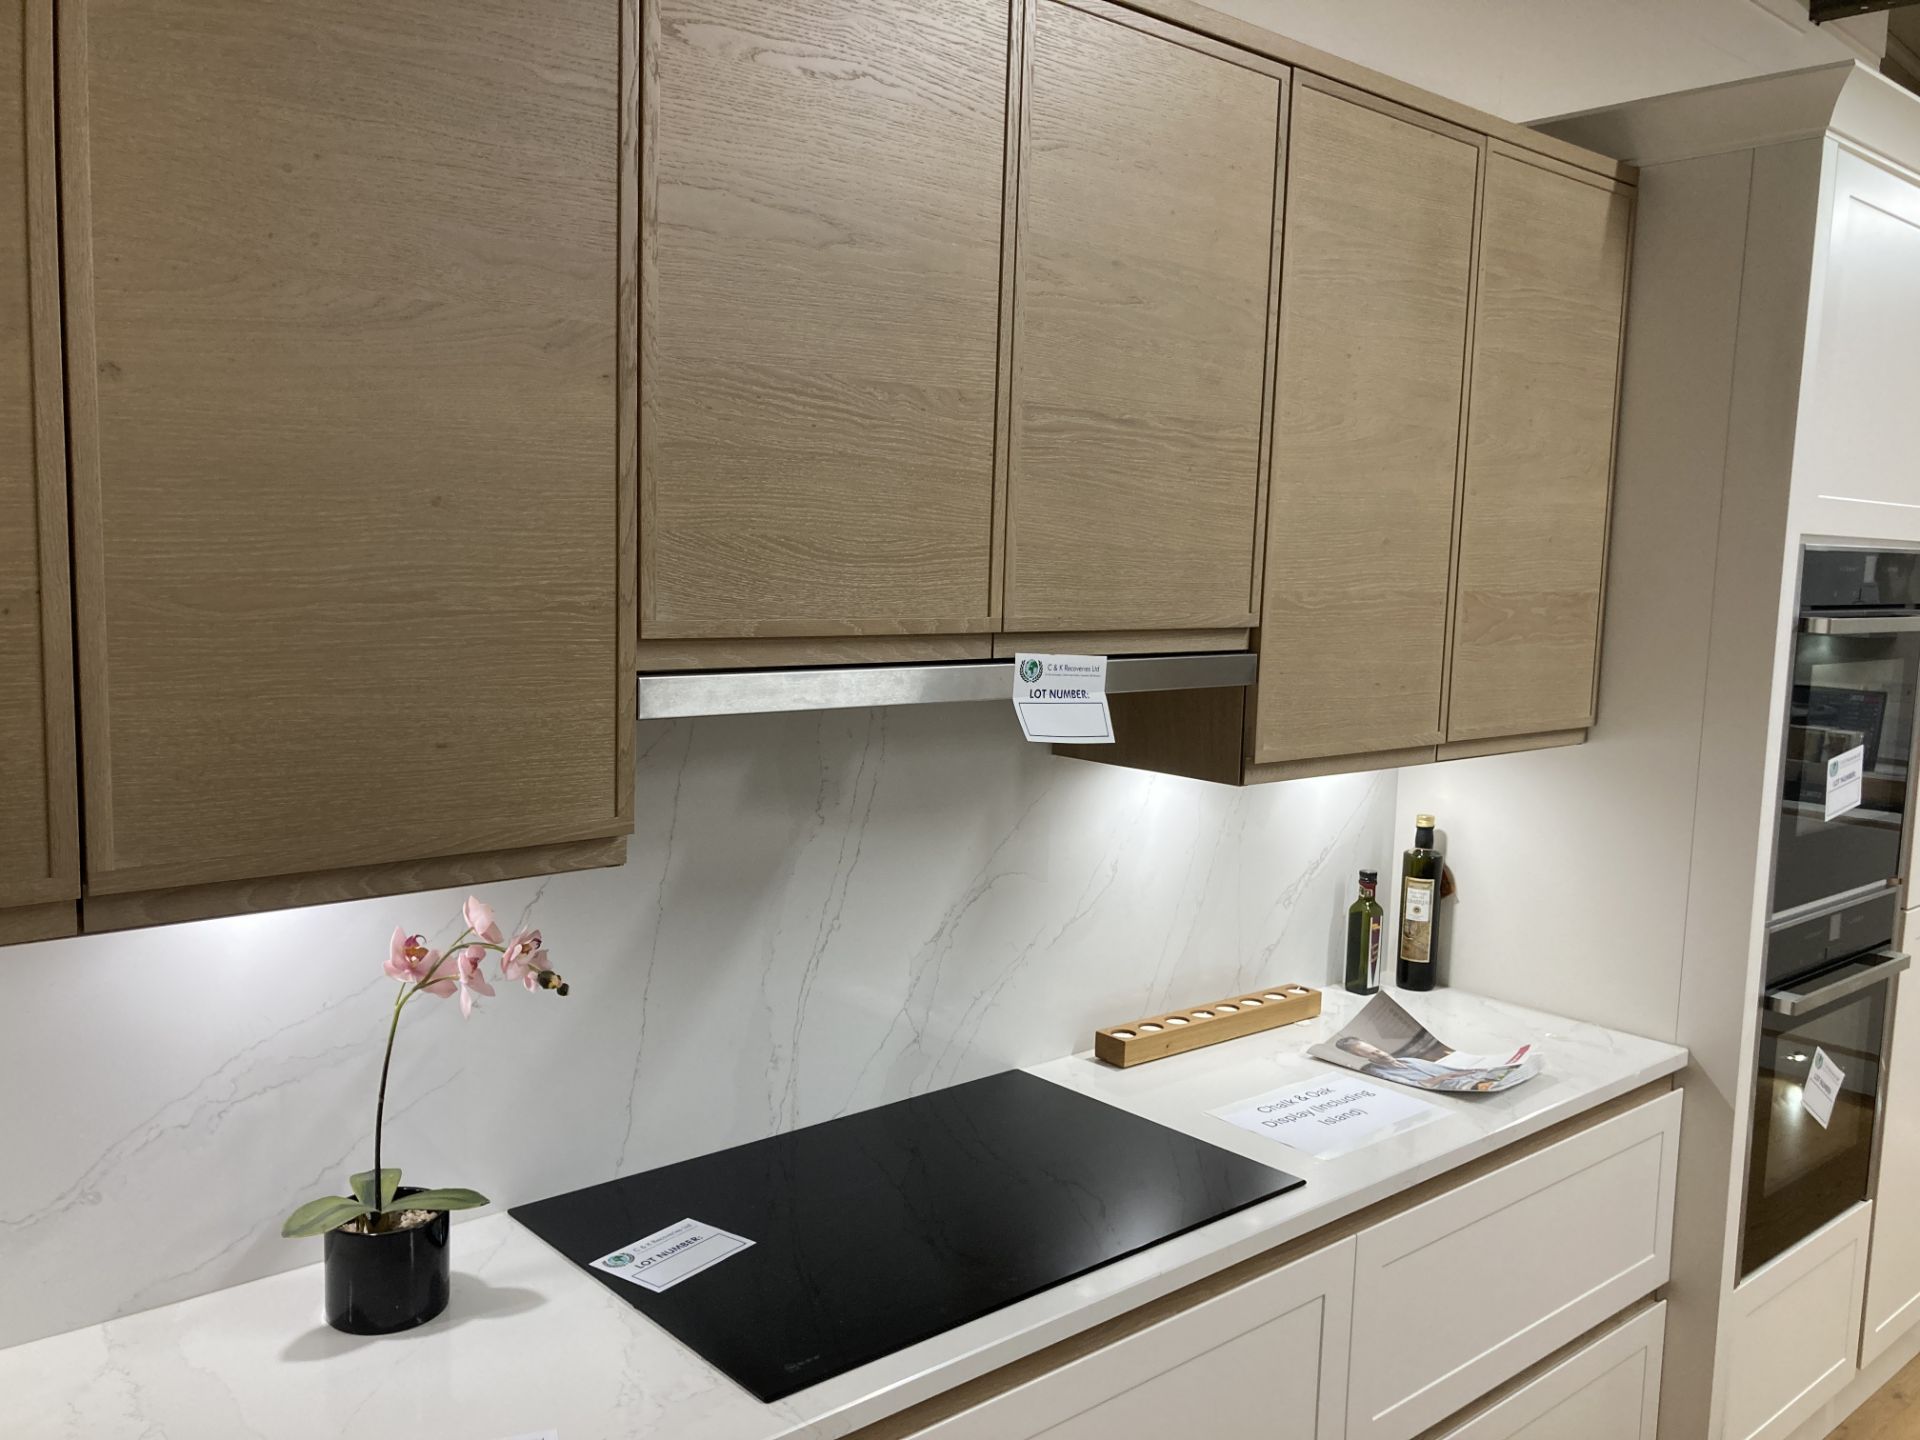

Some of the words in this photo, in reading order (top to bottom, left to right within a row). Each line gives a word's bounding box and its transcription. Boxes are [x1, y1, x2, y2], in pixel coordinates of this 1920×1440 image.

[1047, 664, 1053, 672] C
[1059, 664, 1064, 672] K
[1064, 664, 1091, 673] Recoveries
[1091, 664, 1100, 673] Ltd
[1029, 688, 1047, 699] LOT
[1256, 1097, 1295, 1115] Chalk
[1294, 1092, 1310, 1102] &
[1305, 1087, 1336, 1099] Oak
[1261, 1108, 1316, 1128] Display
[1312, 1088, 1377, 1114] (Including
[1317, 1107, 1368, 1126] Island)
[635, 1256, 657, 1270] LOT
[657, 1235, 704, 1259] NUMBER:
